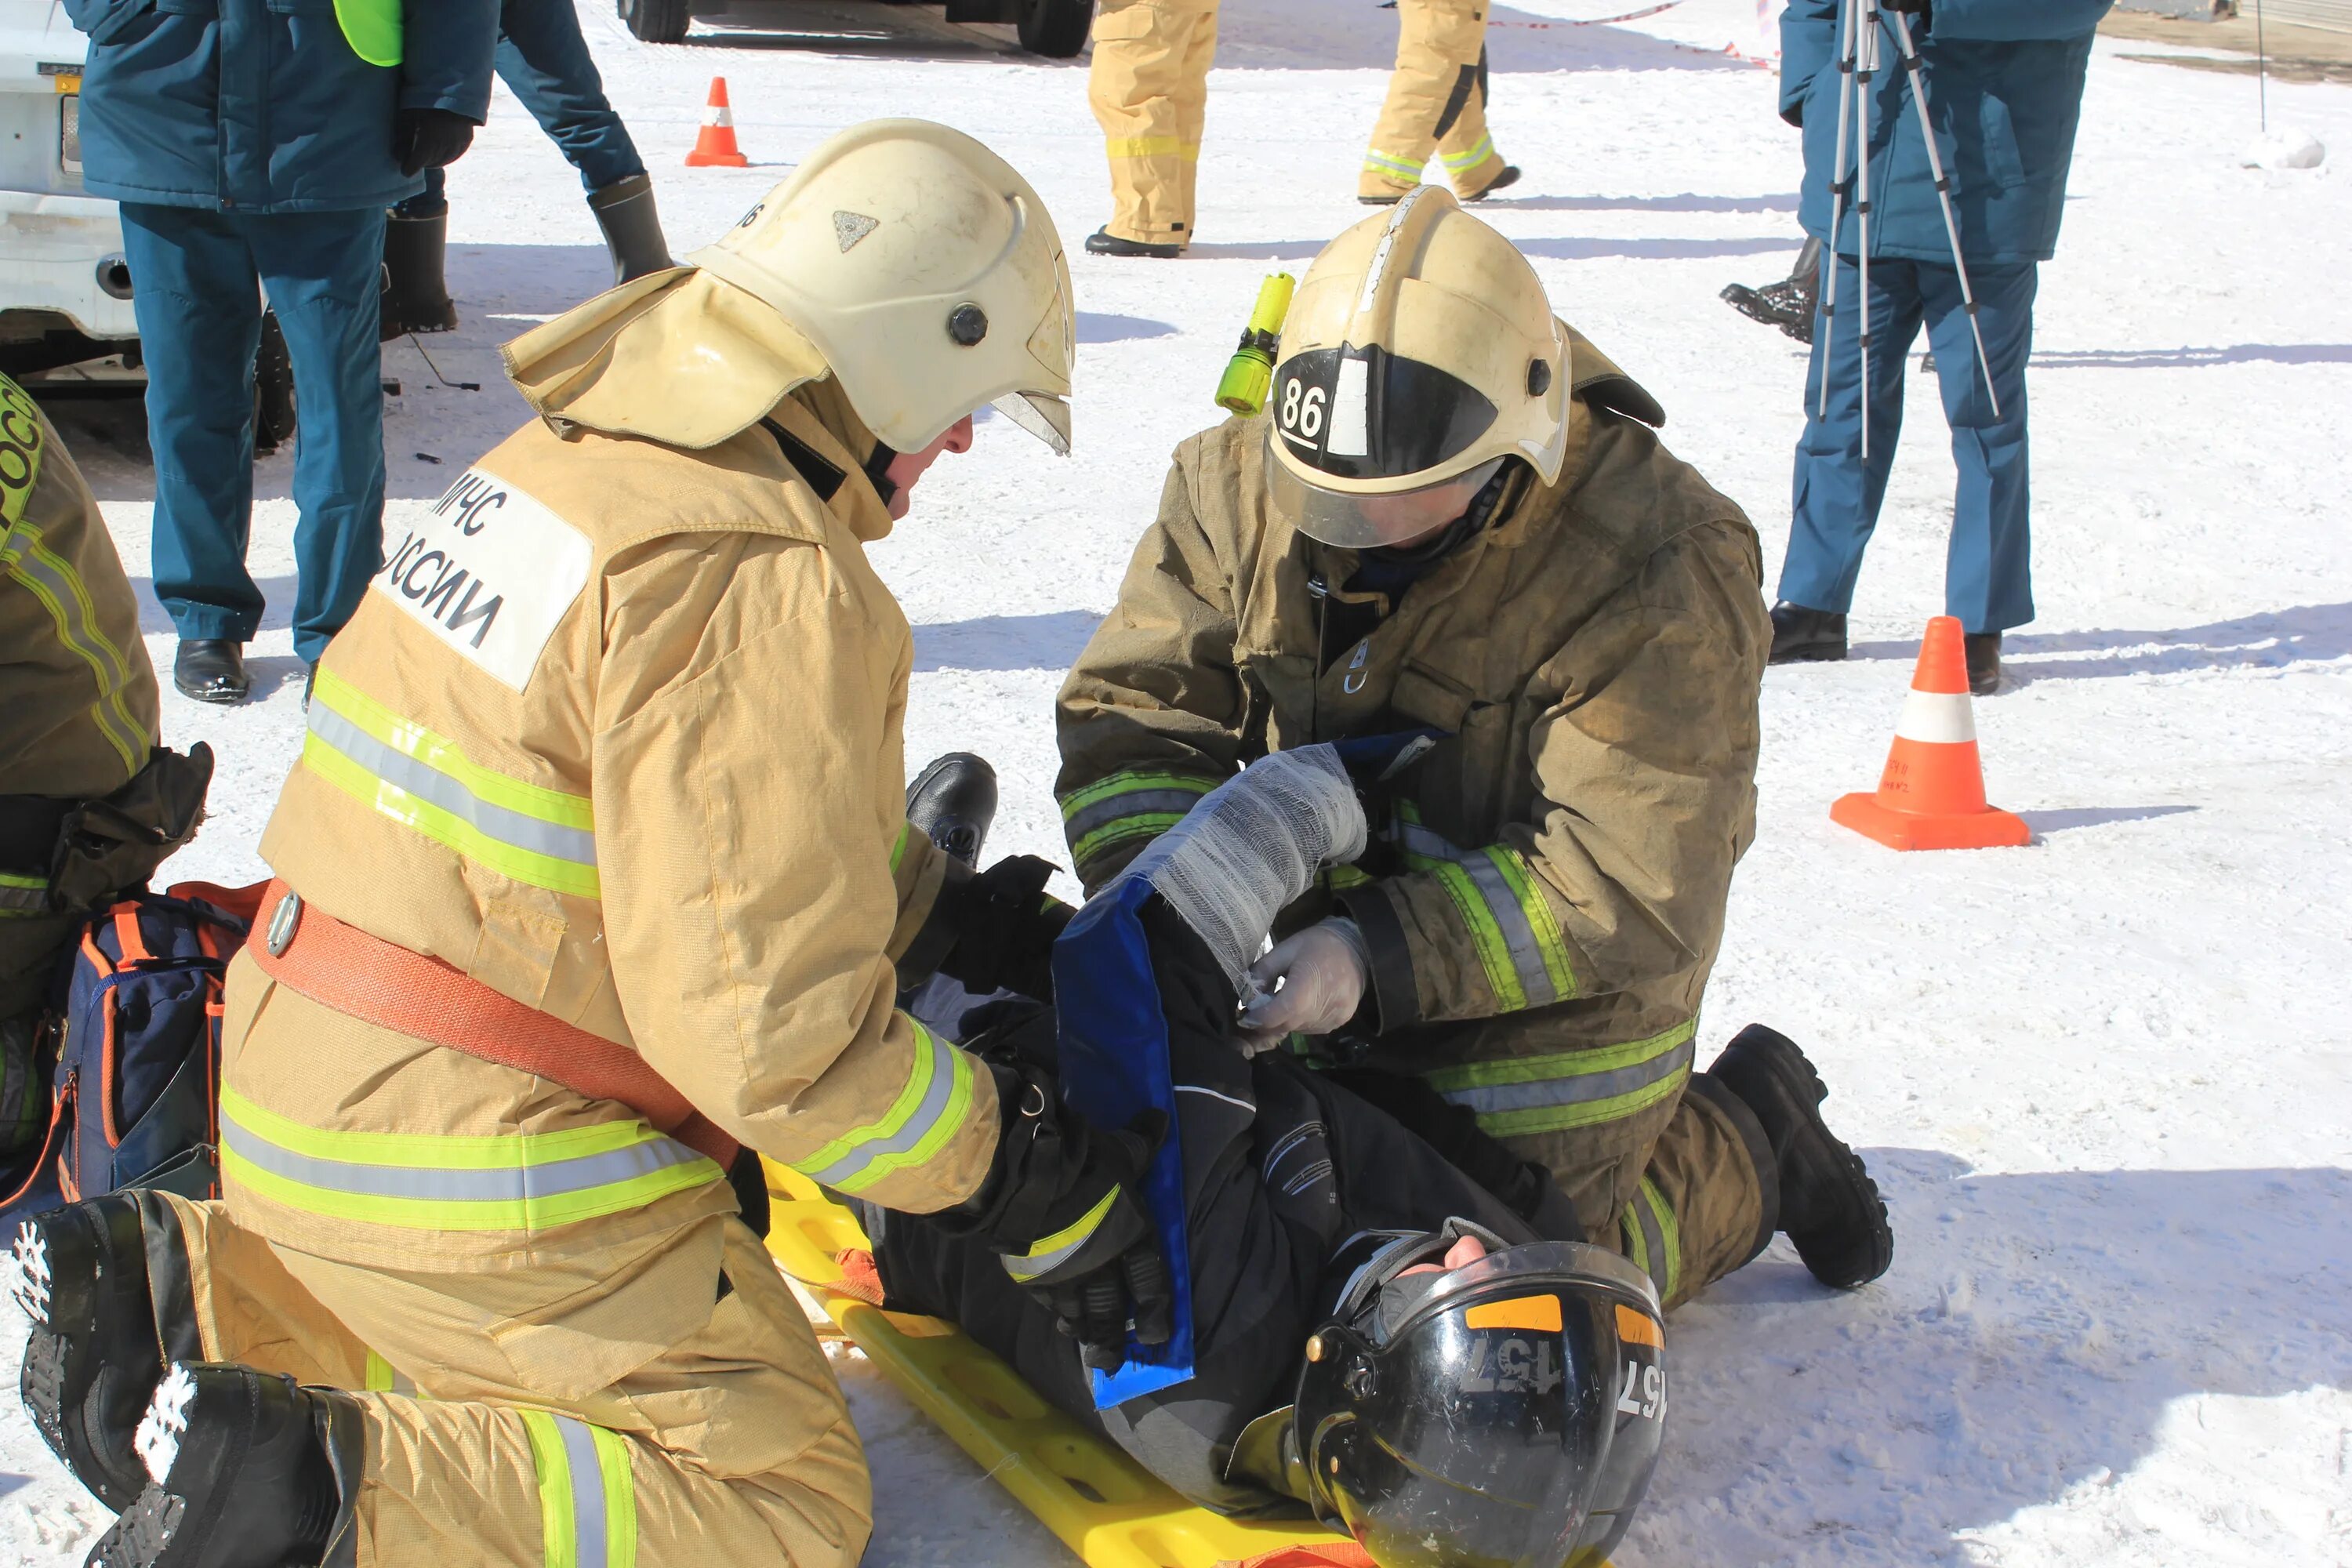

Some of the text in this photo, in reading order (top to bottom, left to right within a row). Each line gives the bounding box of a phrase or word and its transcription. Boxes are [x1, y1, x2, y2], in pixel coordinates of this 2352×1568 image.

[1283, 378, 1326, 437] 86
[1460, 1338, 1562, 1395] 157
[1617, 1360, 1668, 1423] 157
